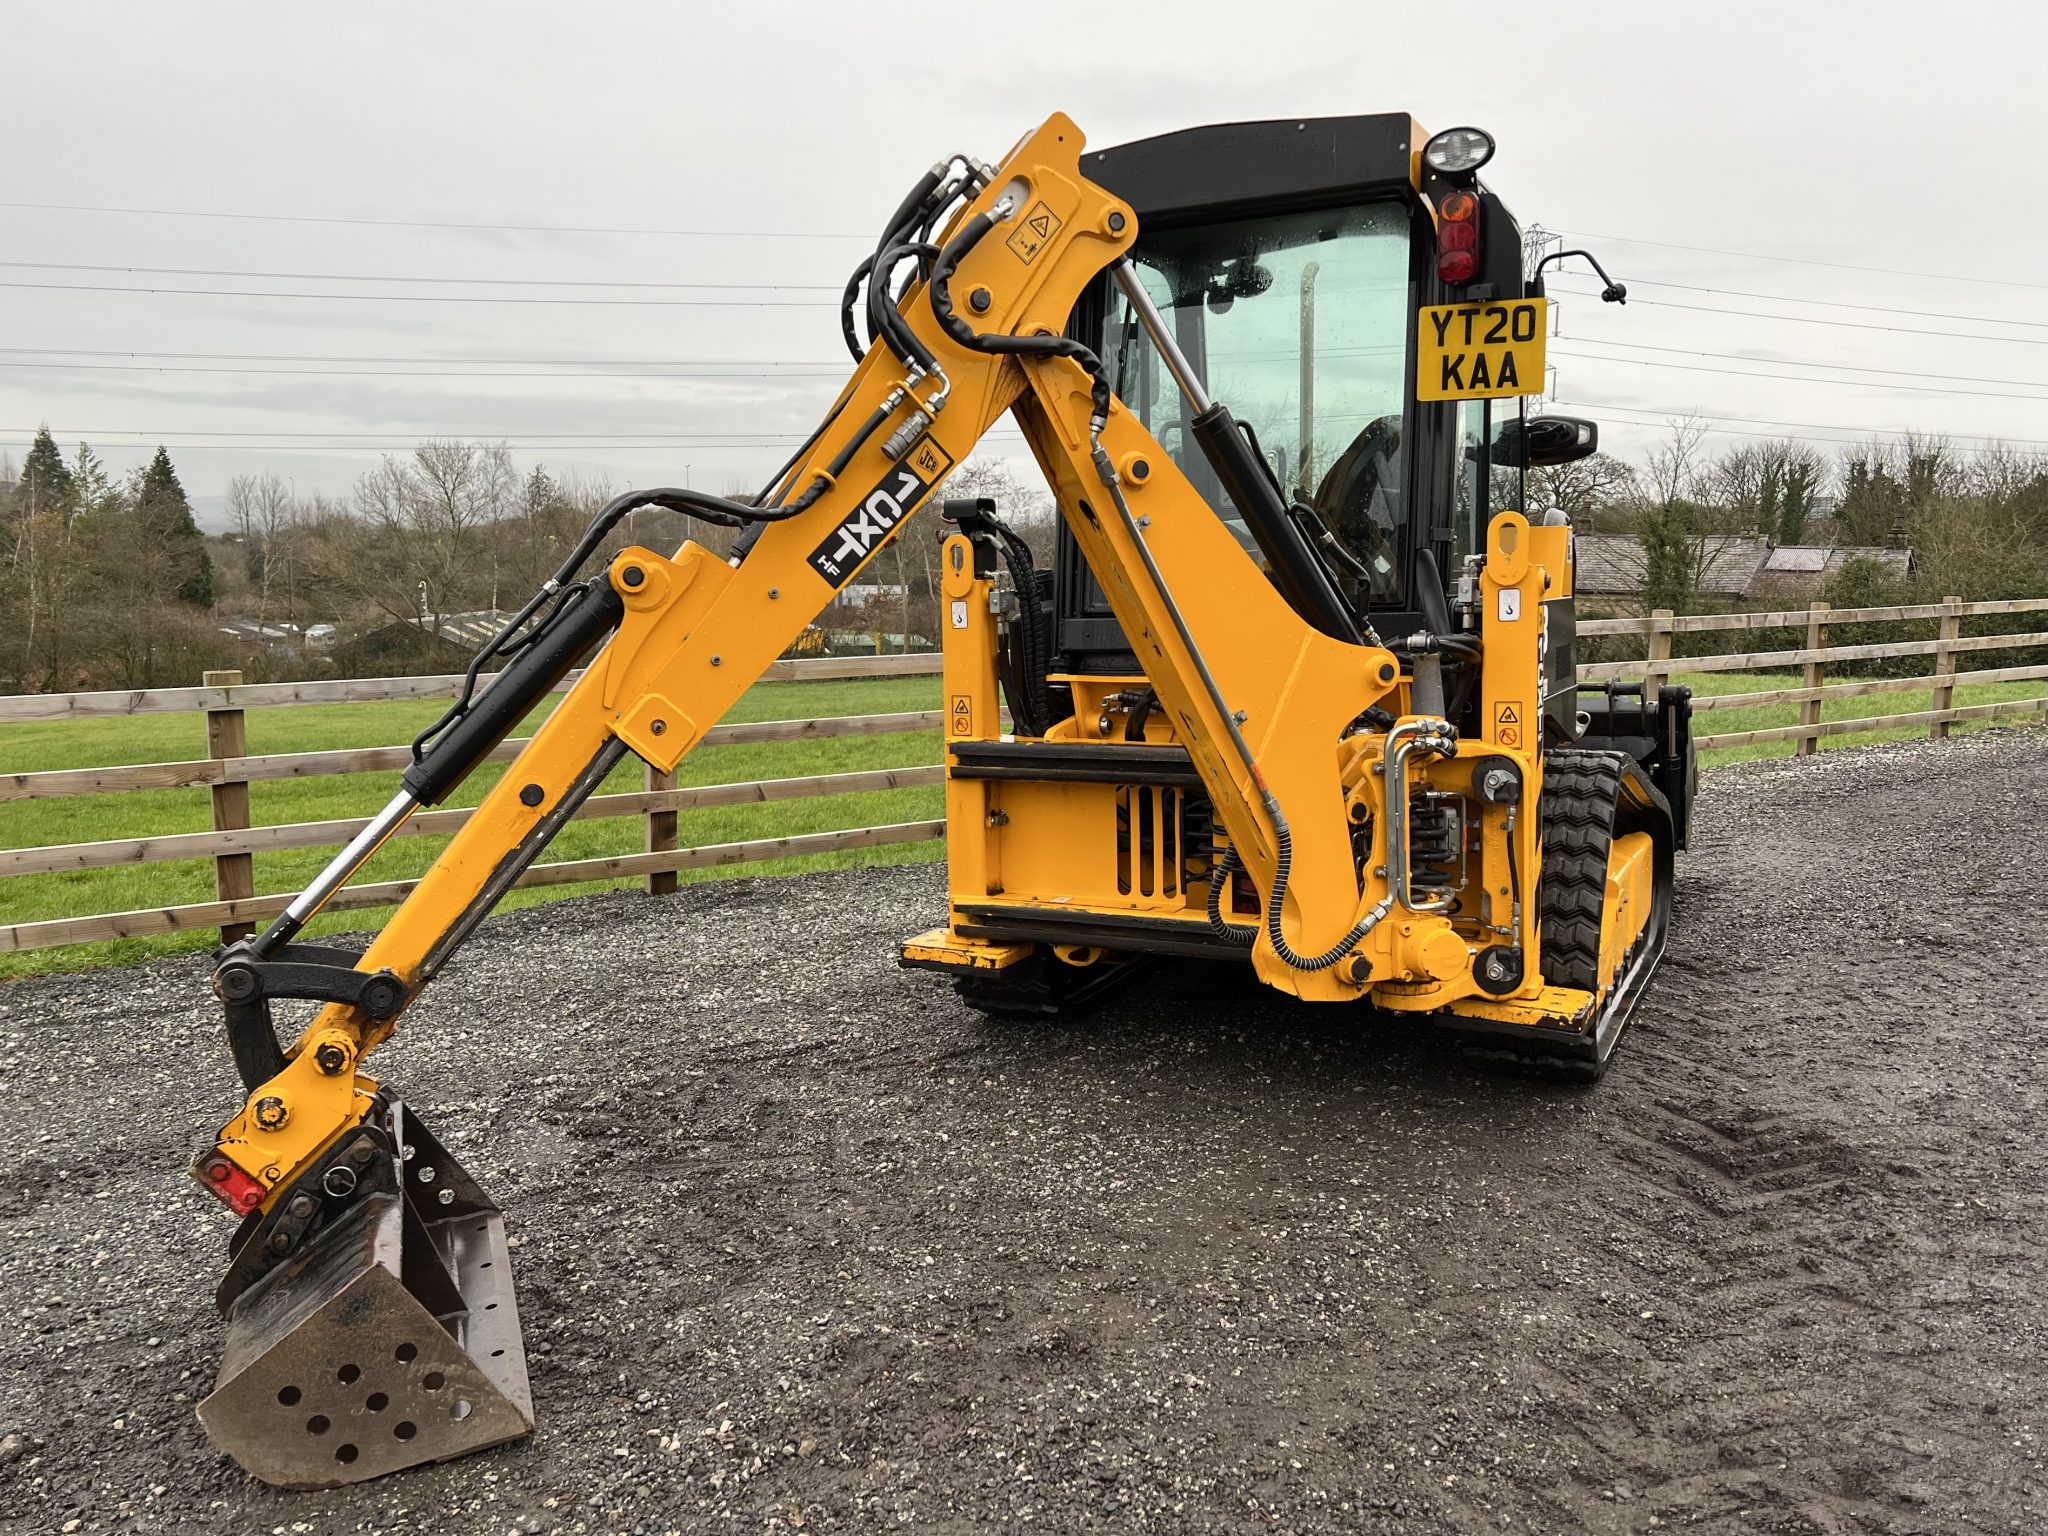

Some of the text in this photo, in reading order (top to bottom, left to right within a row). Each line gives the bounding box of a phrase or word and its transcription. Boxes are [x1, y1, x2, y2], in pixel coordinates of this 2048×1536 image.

[1430, 304, 1536, 347] YT20
[1441, 351, 1519, 391] KAA
[918, 450, 937, 472] JCB
[817, 555, 841, 576] HF
